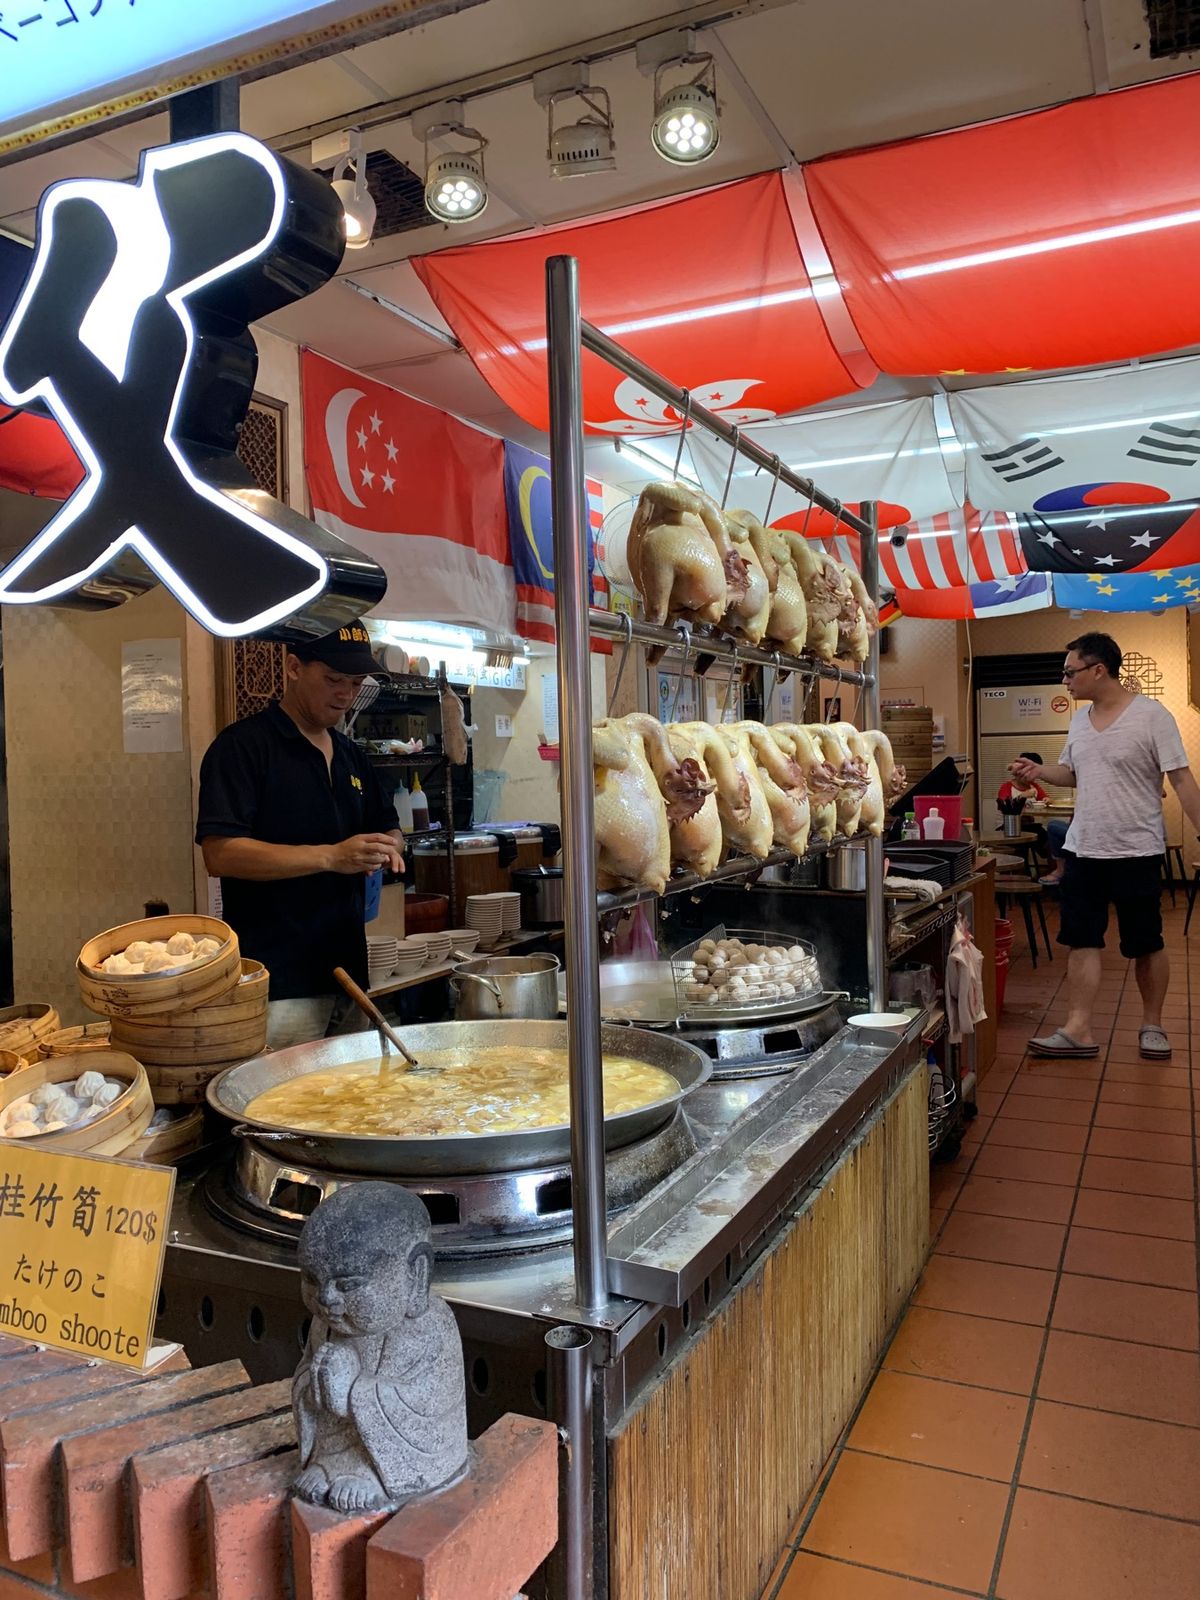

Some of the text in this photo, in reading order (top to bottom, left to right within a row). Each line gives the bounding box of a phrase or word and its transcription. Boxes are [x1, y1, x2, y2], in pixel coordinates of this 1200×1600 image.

[1018, 697, 1042, 706] Wi-Fi
[0, 1173, 158, 1244] 桂竹筍 120$
[13, 1253, 107, 1298] たけのこ
[59, 1313, 140, 1358] shoote
